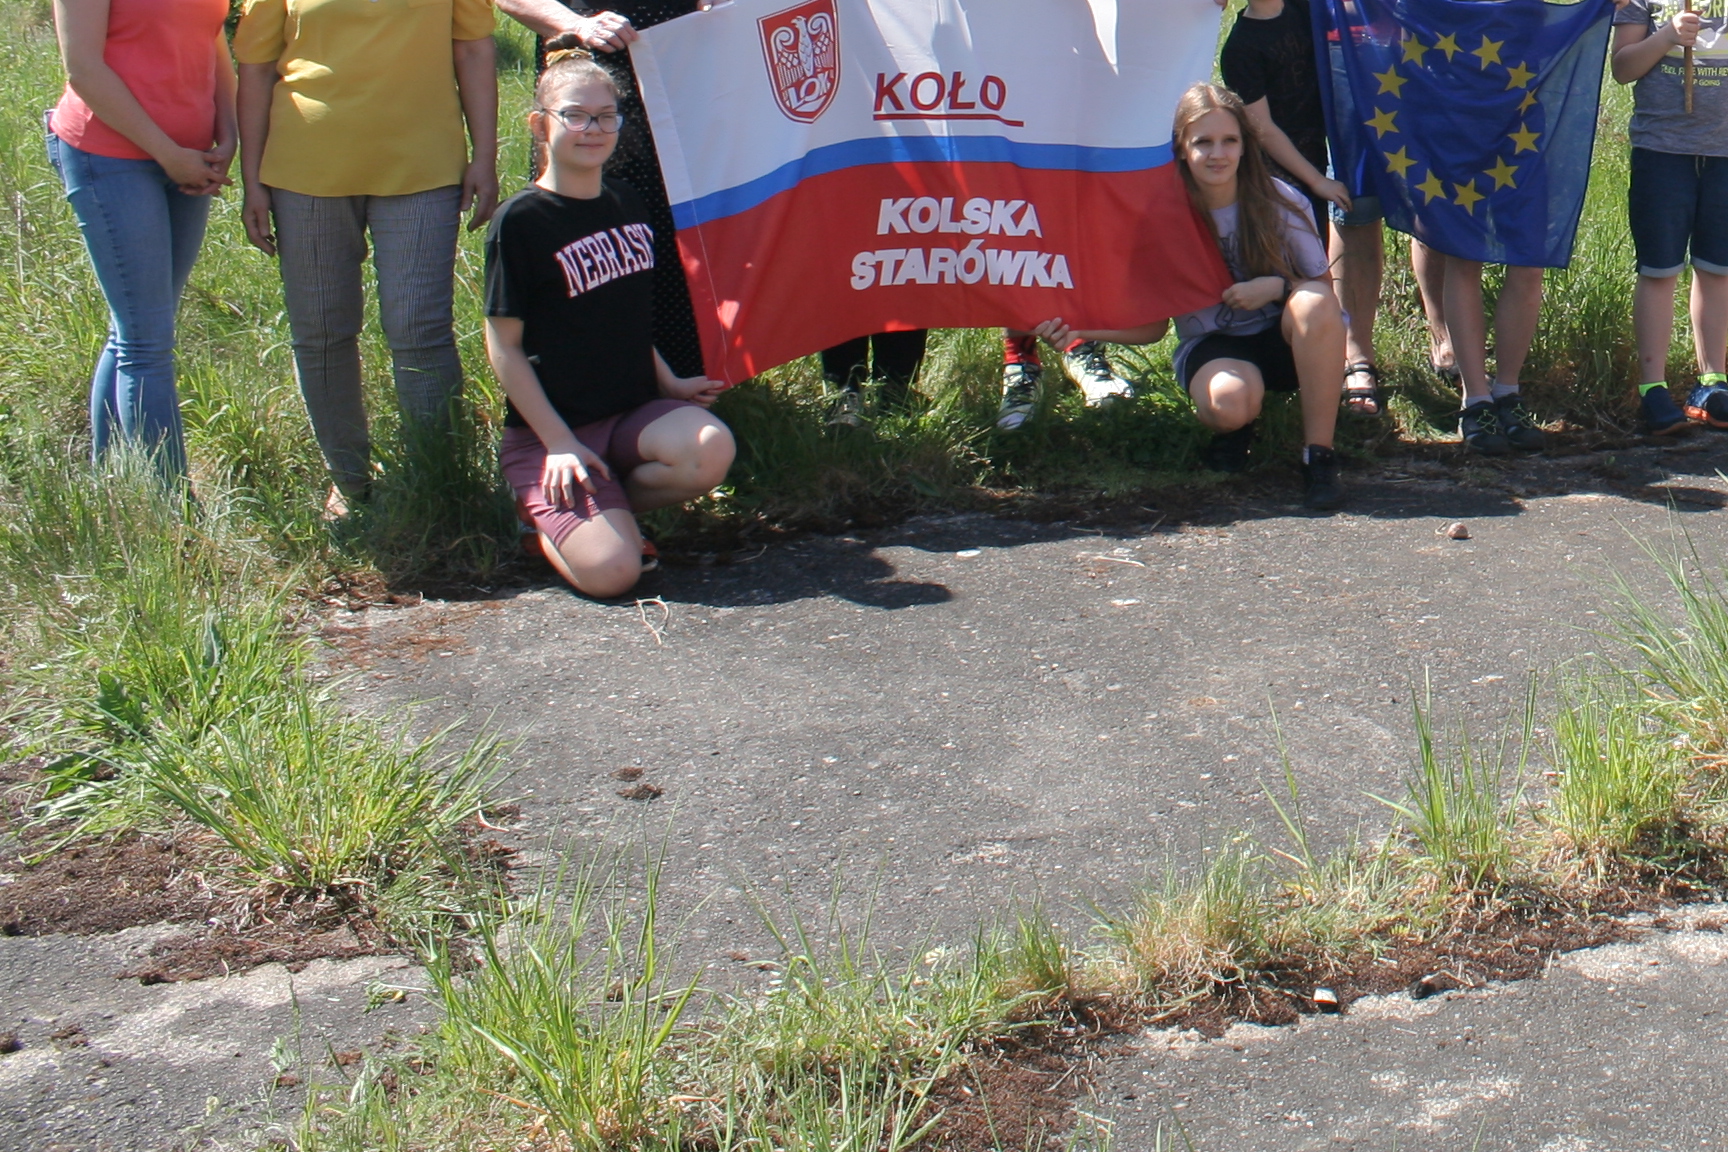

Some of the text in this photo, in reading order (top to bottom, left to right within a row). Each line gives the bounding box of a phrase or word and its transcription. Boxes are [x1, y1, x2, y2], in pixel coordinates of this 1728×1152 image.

[872, 71, 1008, 112] KOŁO
[876, 196, 1044, 239] KOLSKA
[850, 238, 1075, 291] STARÓWKA
